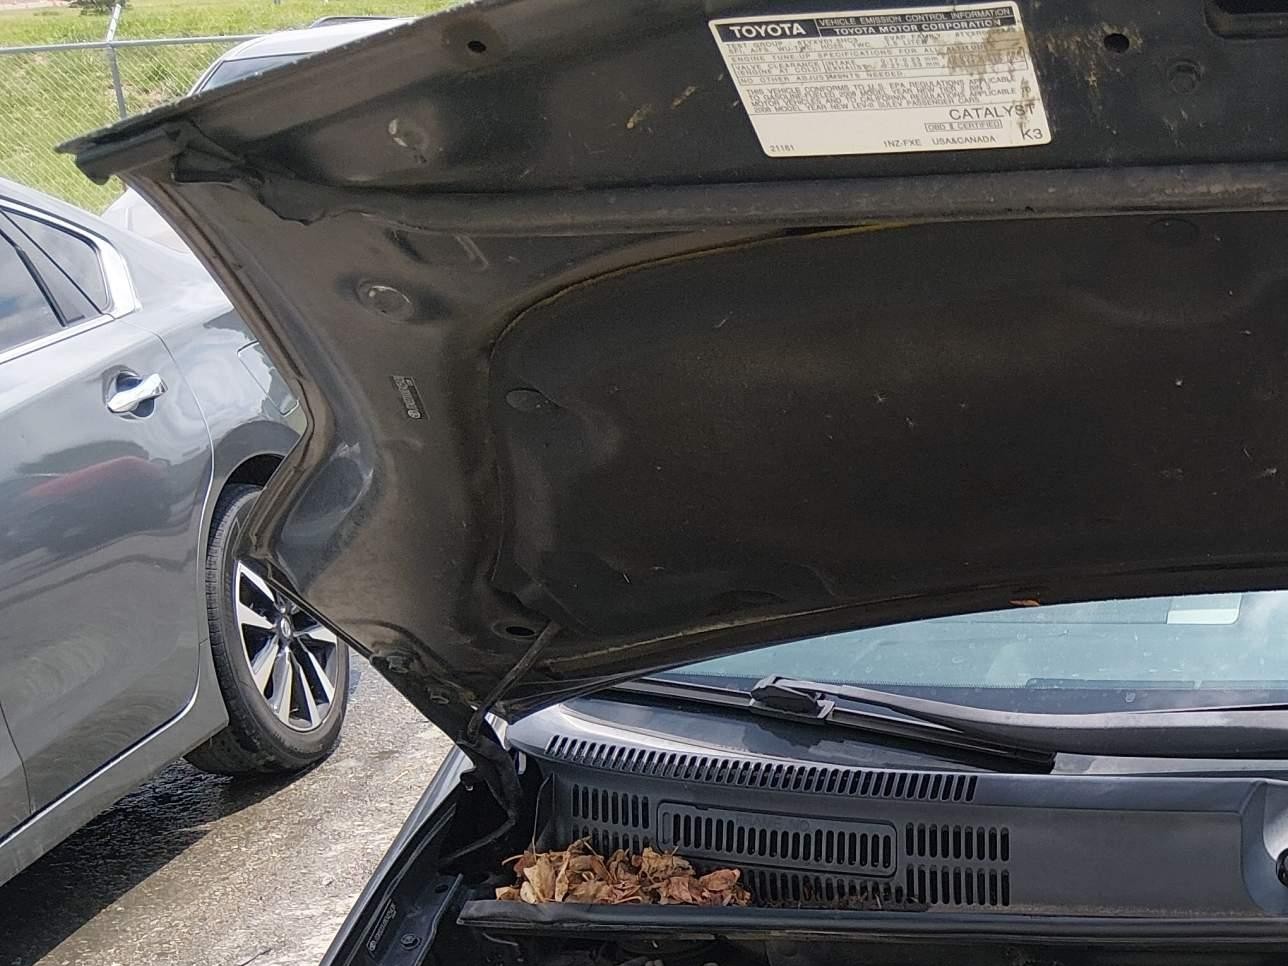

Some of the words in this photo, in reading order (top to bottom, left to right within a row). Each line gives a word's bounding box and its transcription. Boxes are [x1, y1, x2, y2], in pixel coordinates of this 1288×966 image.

[818, 17, 857, 26] VEHICLE
[860, 14, 901, 25] EMISSION
[905, 11, 948, 22] CONTROL
[950, 7, 1011, 19] INFORMATION
[728, 22, 807, 39] TOYOTA
[834, 26, 876, 36] TOYOTA
[879, 24, 918, 33] MOTOR
[921, 19, 1001, 31] CORPORATION
[949, 102, 1036, 121] CATALYST
[1020, 128, 1044, 141] K3
